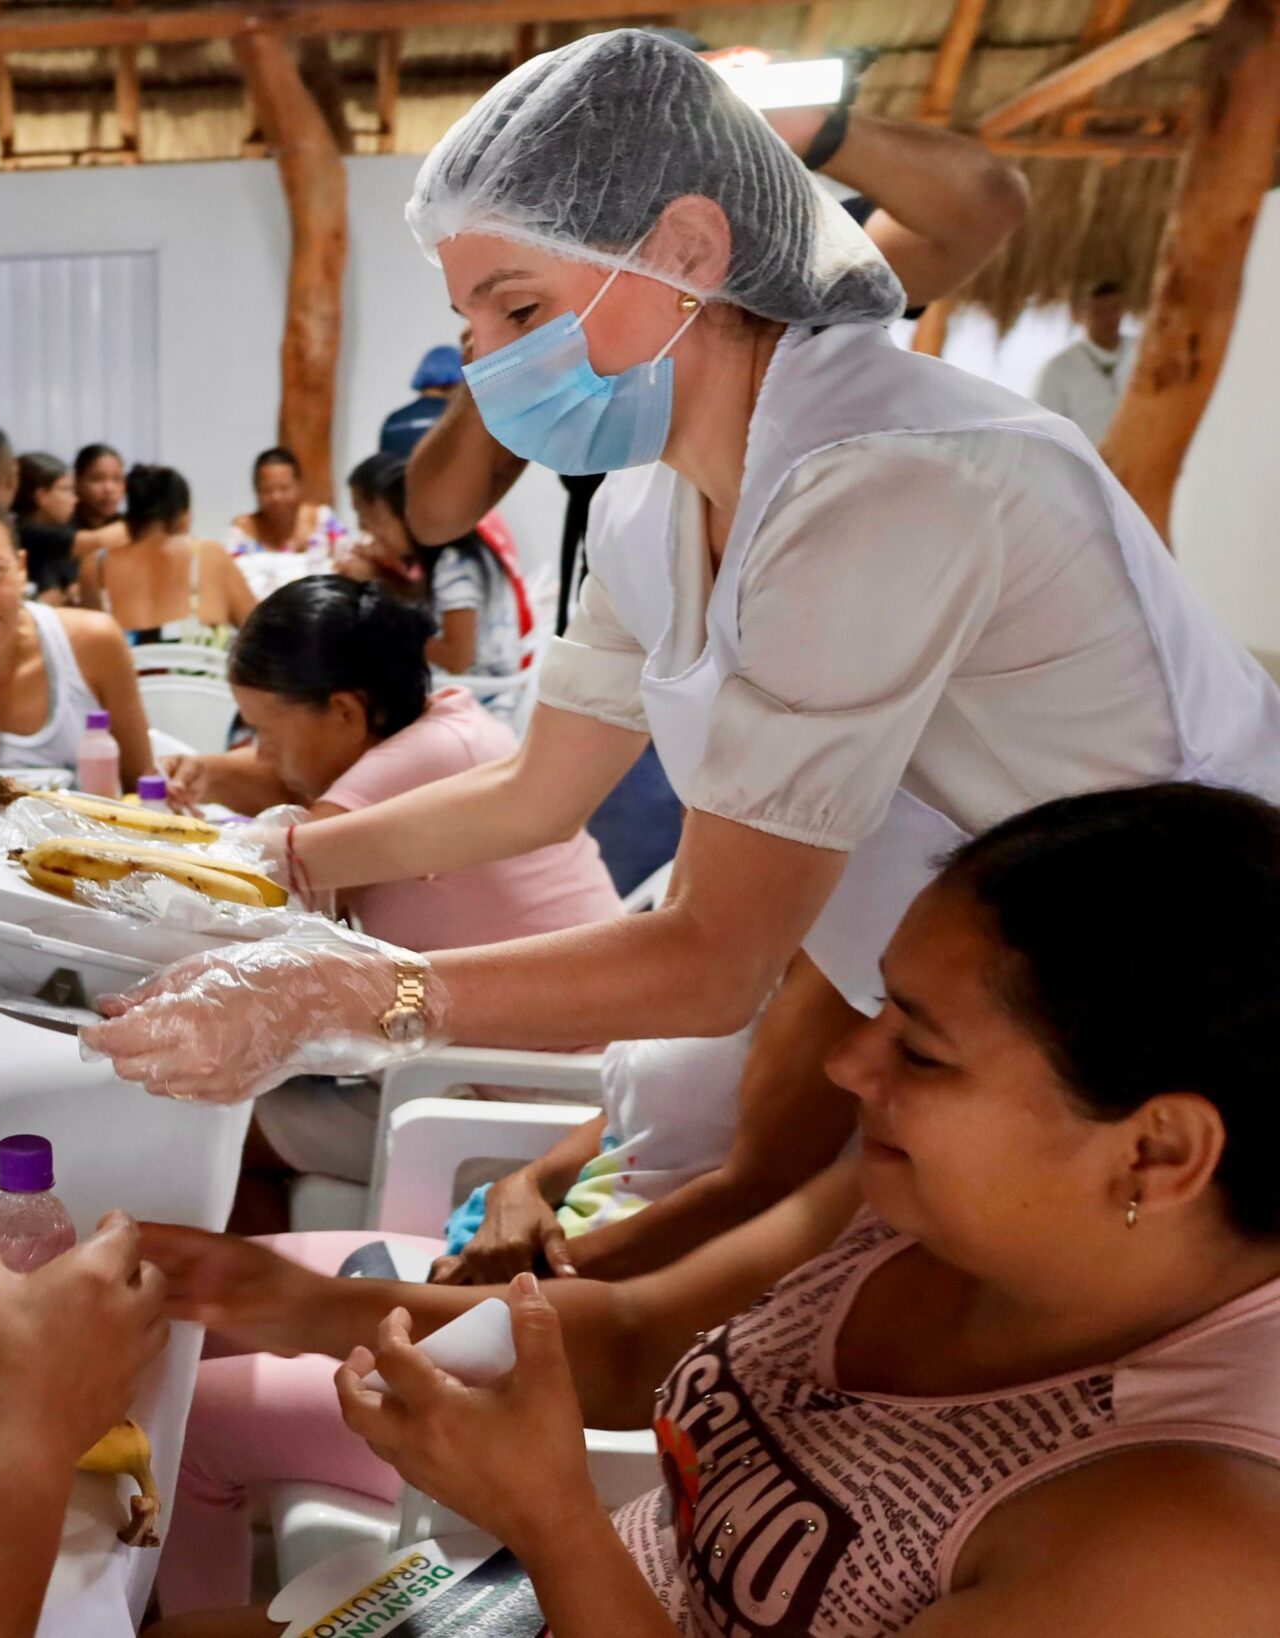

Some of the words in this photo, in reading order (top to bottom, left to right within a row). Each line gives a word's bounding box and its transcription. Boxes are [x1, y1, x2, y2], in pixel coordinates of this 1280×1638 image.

[656, 1353, 828, 1627] SCHINO
[872, 1528, 903, 1565] the
[864, 1553, 895, 1592] the
[314, 1556, 430, 1638] GRATUITO
[866, 1585, 893, 1611] to
